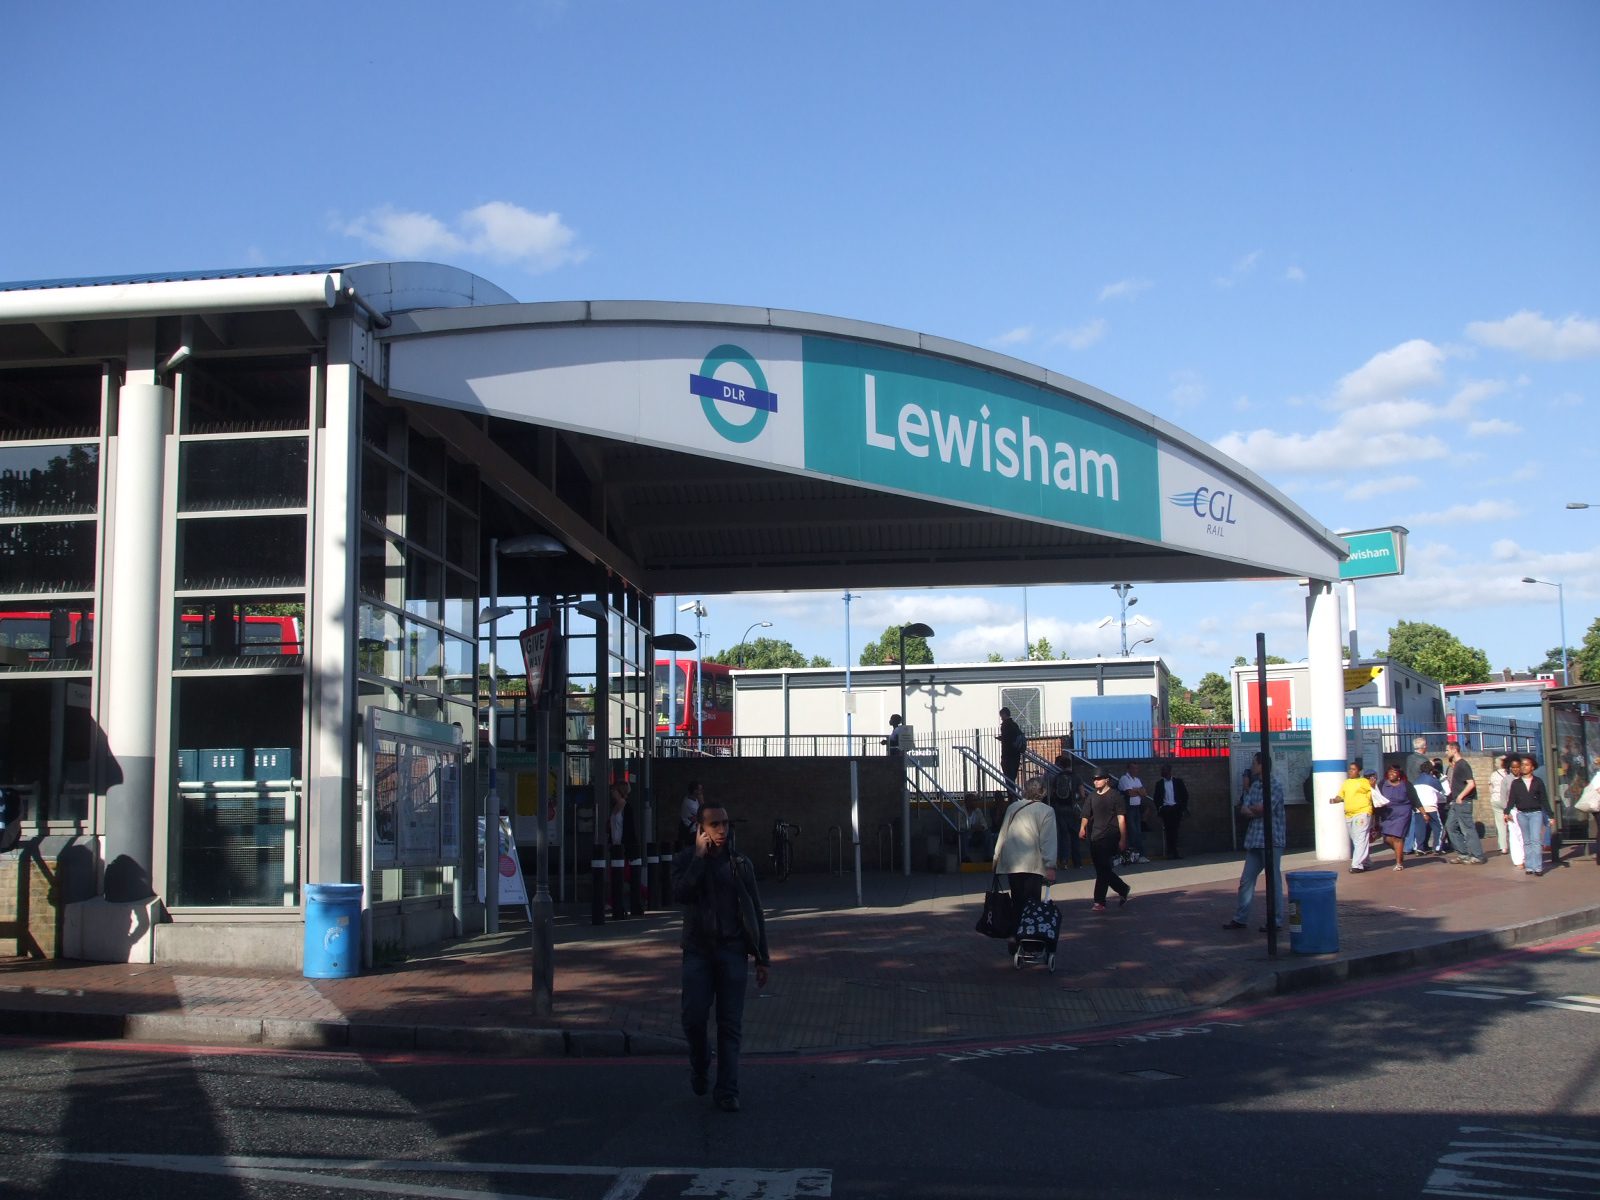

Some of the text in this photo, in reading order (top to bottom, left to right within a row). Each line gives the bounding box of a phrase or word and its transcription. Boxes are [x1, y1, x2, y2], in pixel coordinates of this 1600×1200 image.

[723, 386, 746, 402] DLR
[864, 373, 1119, 501] Lewisham
[1193, 486, 1236, 525] CGL
[1206, 524, 1224, 537] RAIL
[1350, 548, 1389, 561] wisham
[526, 634, 545, 654] GIVE
[529, 655, 542, 668] WAY
